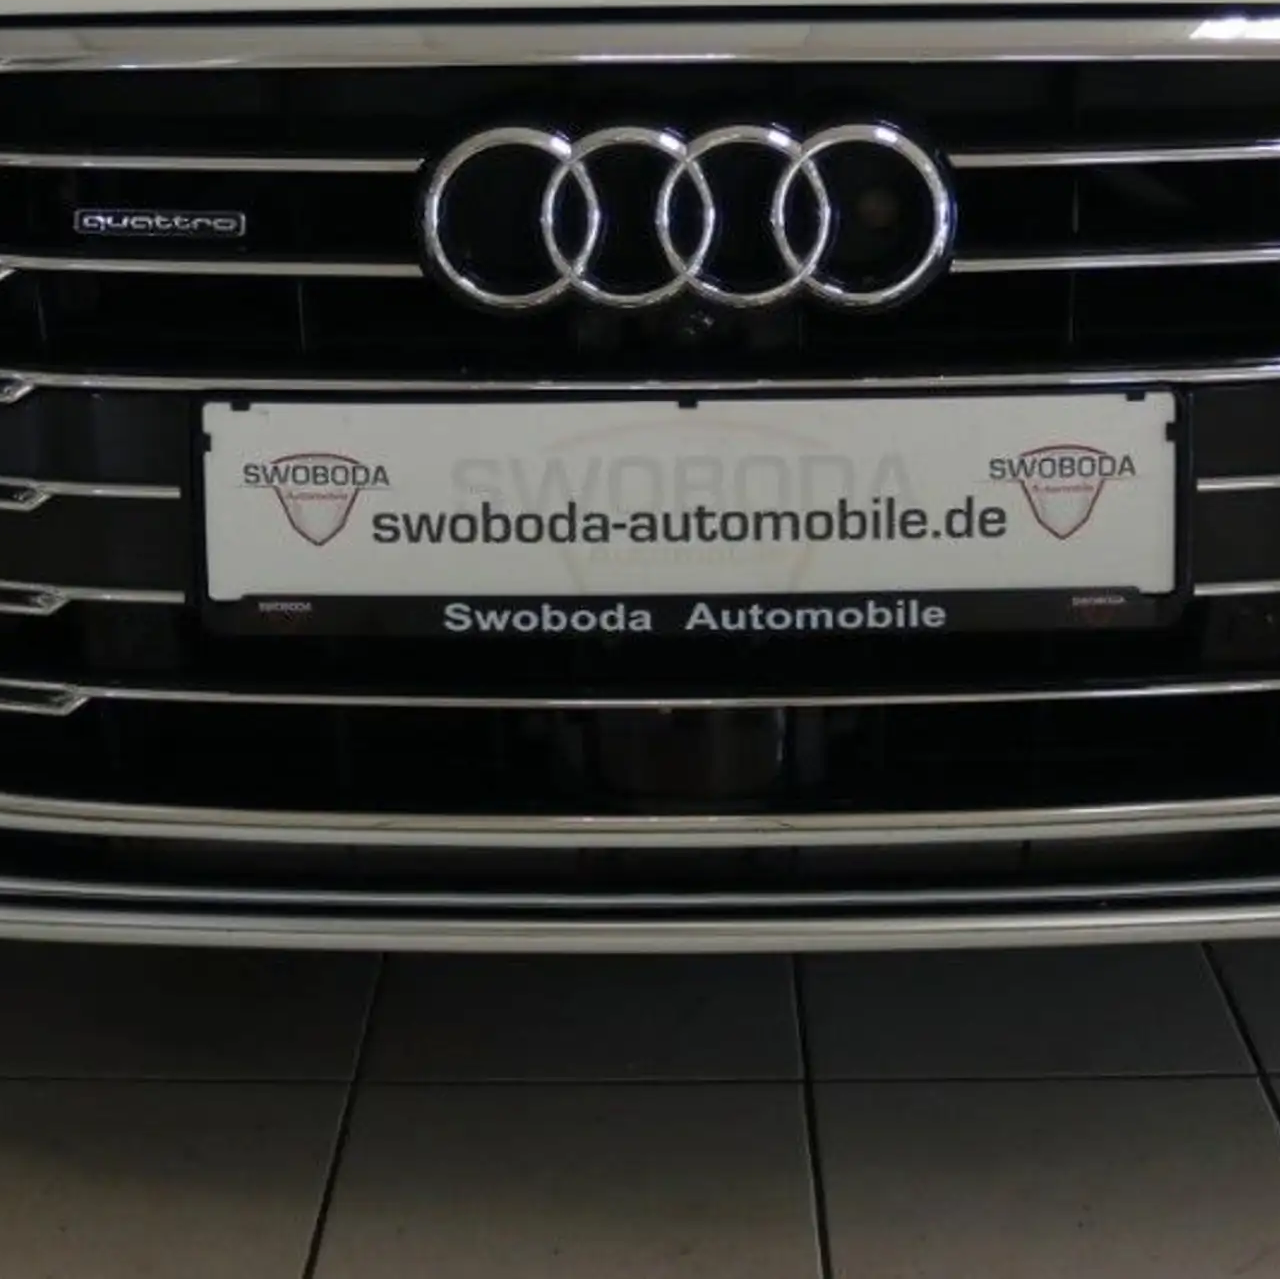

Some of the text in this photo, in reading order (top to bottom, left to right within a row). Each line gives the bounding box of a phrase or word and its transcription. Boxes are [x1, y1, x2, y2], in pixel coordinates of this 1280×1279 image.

[82, 214, 238, 231] quattro
[242, 463, 391, 487] SWOBODA
[988, 454, 1137, 480] SWOBODA
[372, 496, 1007, 544] swoboda-automobile.de
[443, 600, 947, 633] Swoboda Automobile
